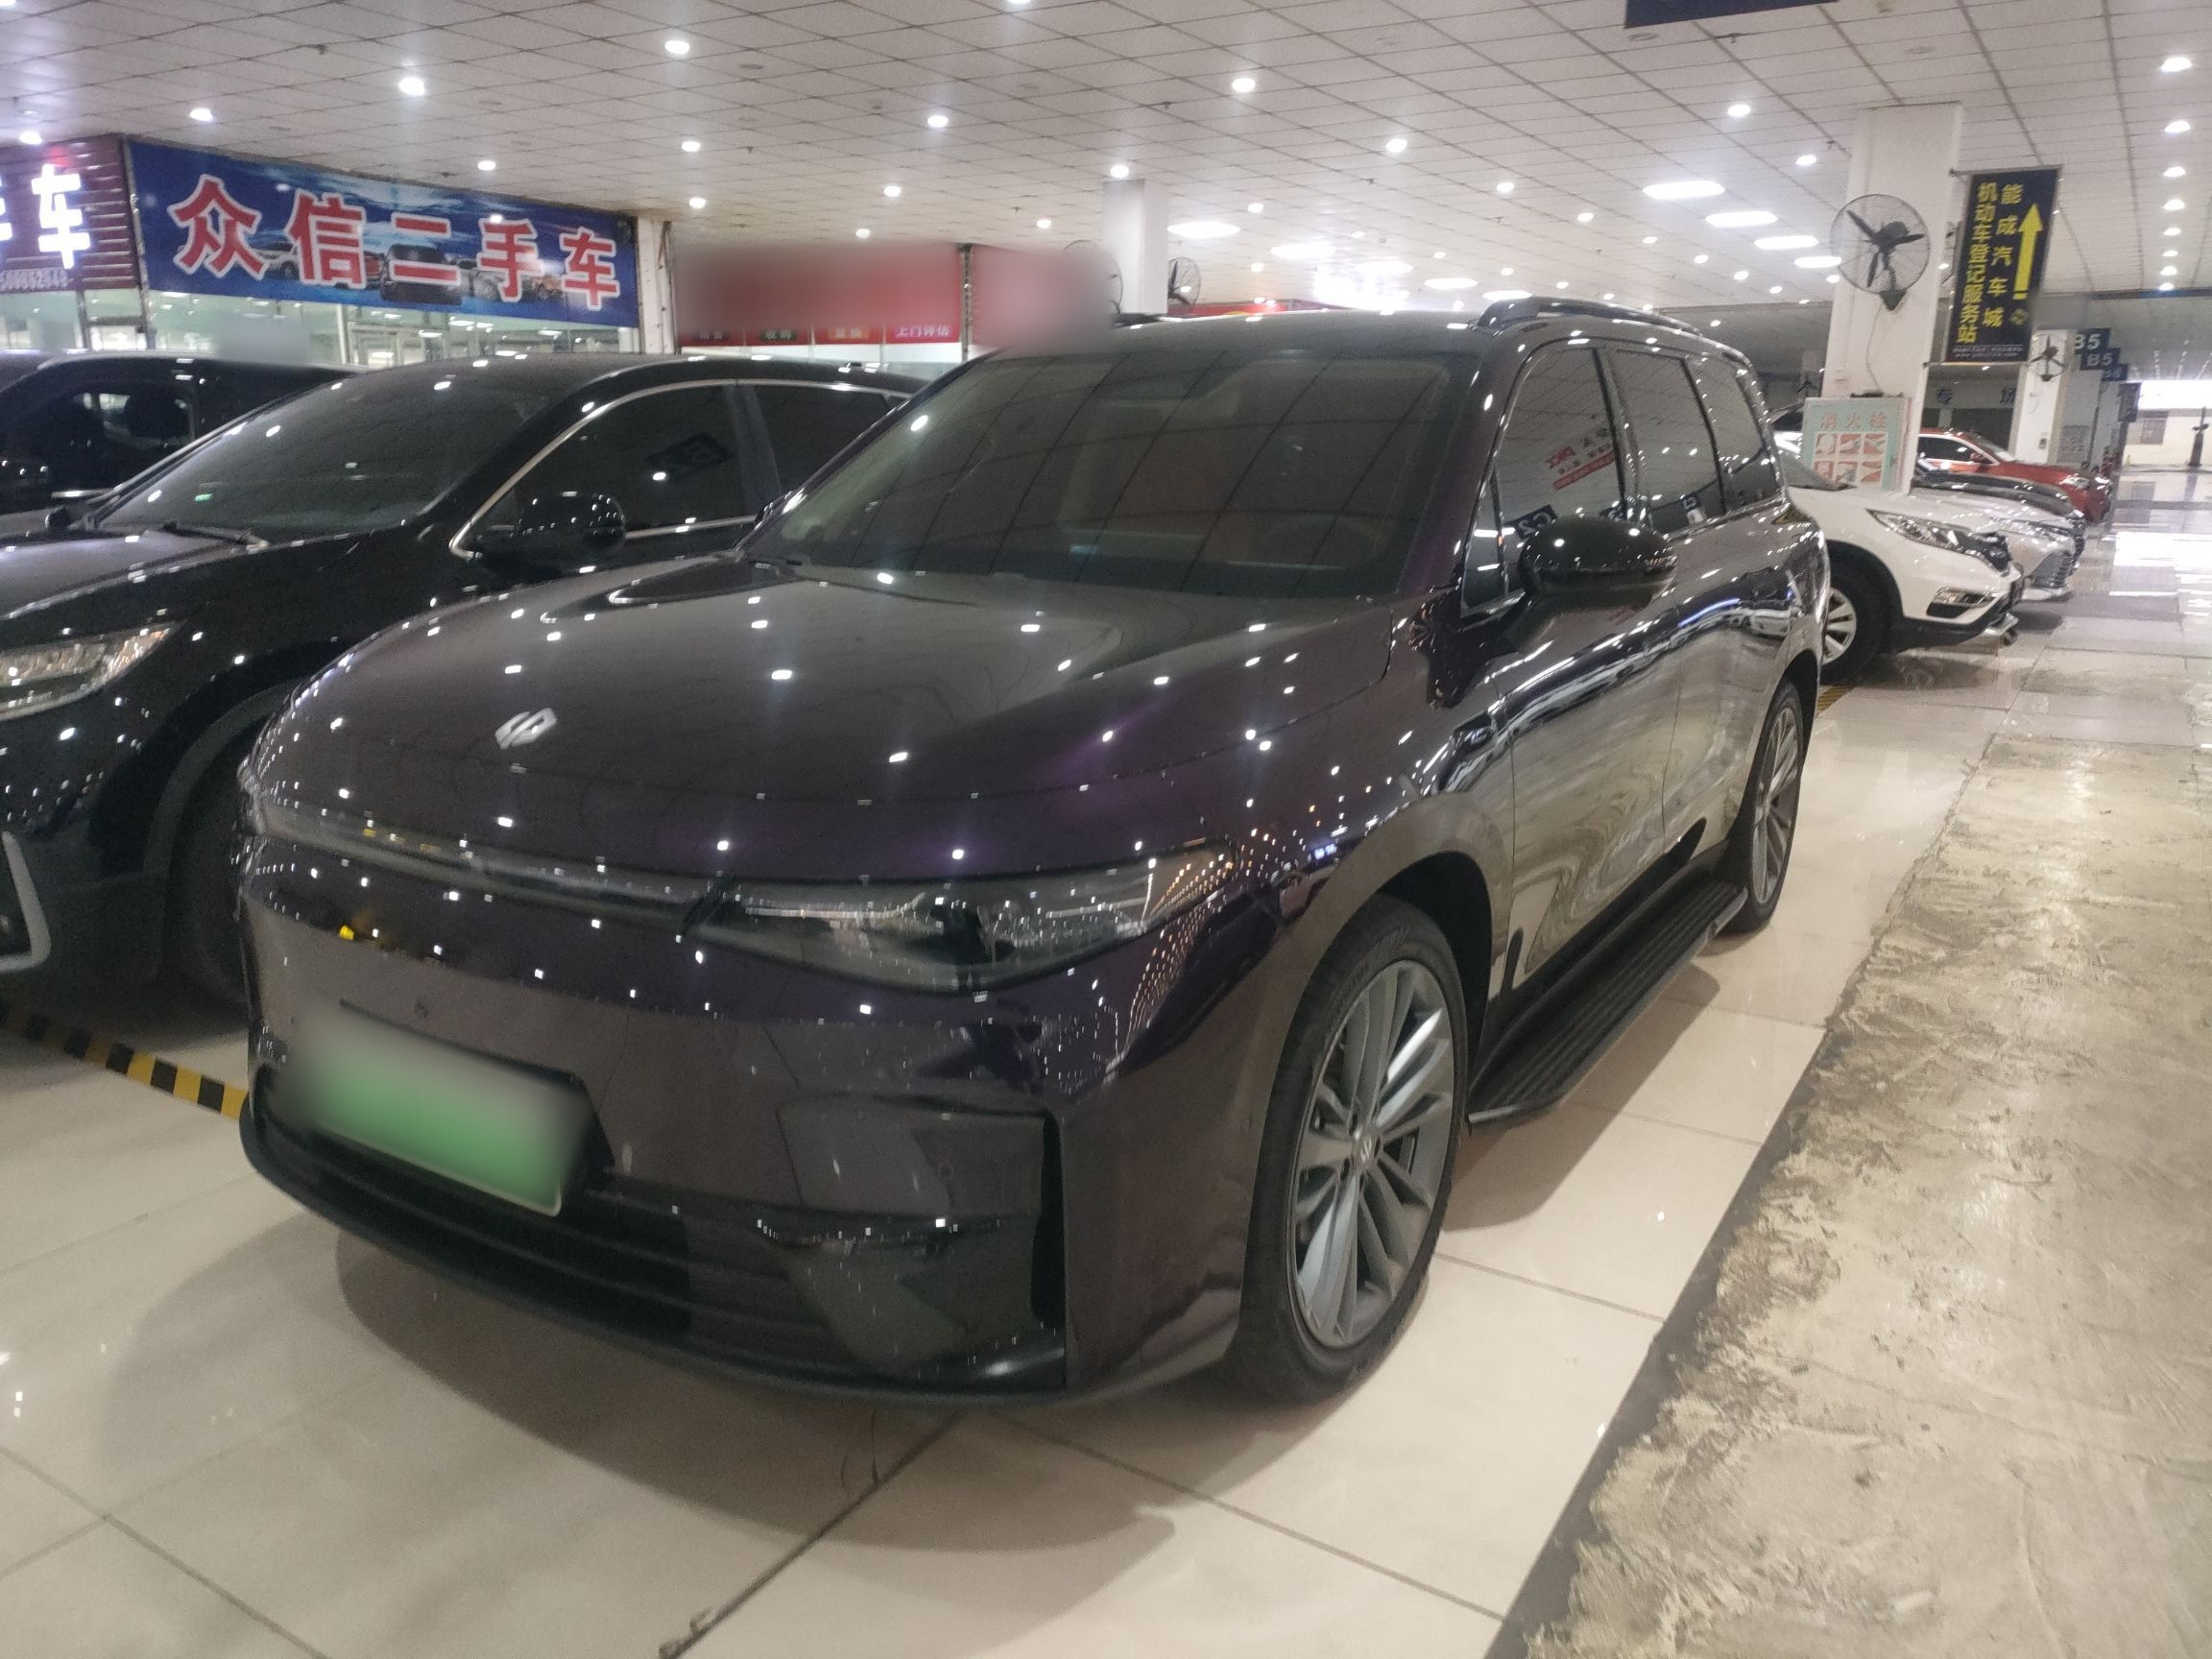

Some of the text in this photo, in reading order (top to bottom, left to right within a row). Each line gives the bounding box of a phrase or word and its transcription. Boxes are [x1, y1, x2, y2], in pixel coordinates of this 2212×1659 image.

[167, 173, 621, 311] 众信二手车
[1956, 181, 1998, 343] 机动车登记服务站
[1983, 183, 2024, 327] 能成汽车城
